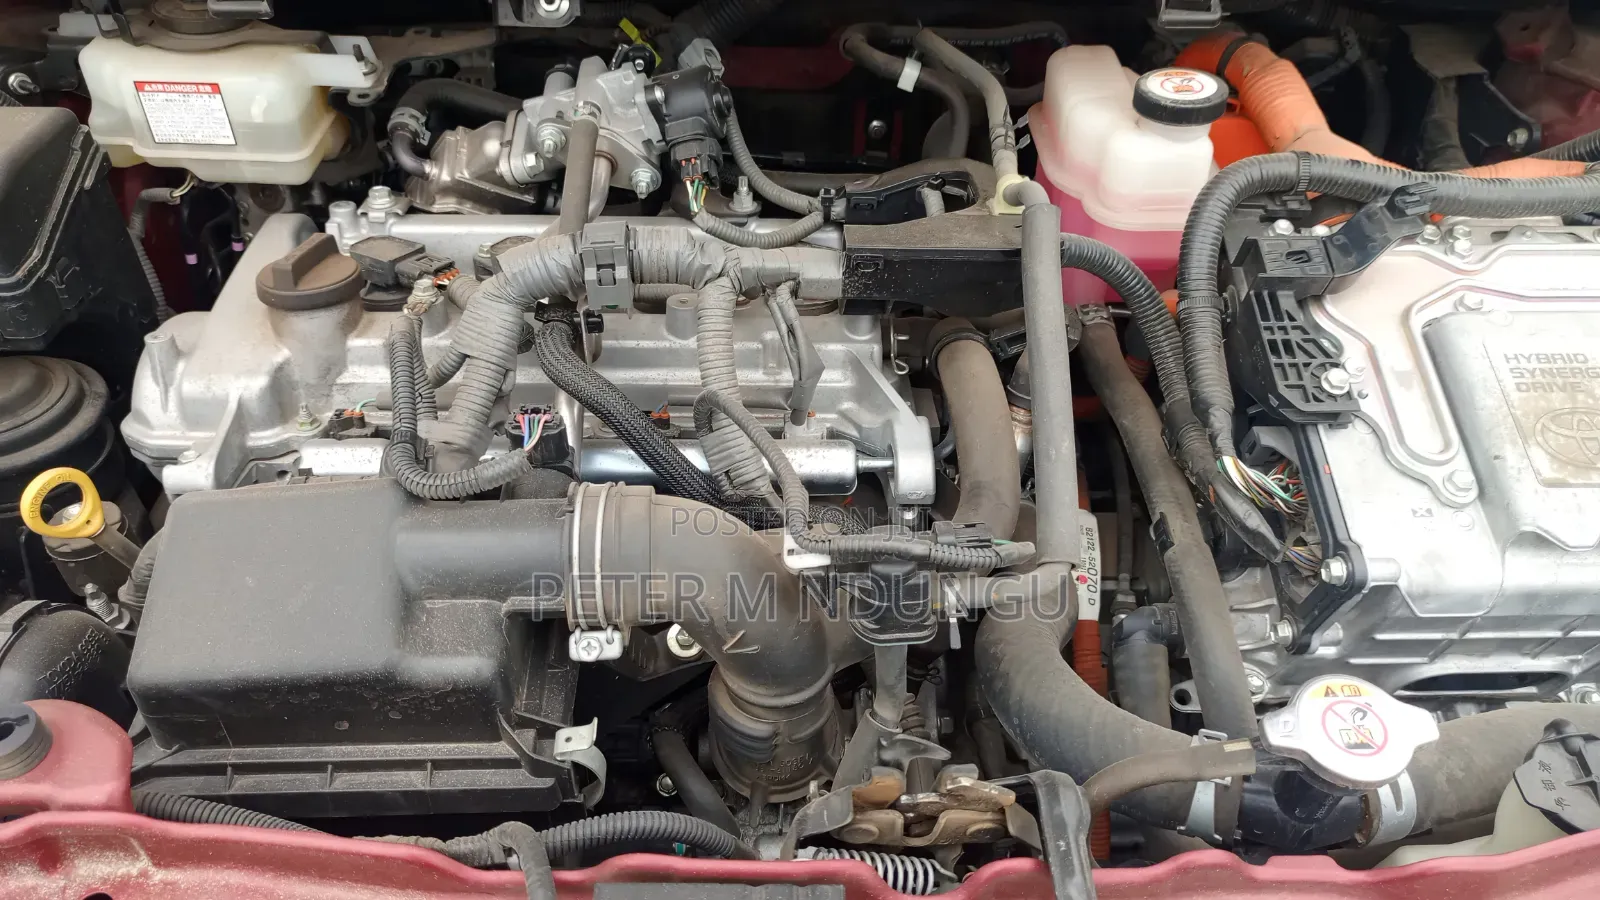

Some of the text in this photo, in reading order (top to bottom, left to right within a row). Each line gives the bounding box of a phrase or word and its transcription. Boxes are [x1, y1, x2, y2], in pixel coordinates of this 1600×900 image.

[164, 83, 199, 93] DANGER
[1503, 353, 1589, 364] HYBRID
[1514, 381, 1585, 393] DRIVE
[29, 472, 73, 519] ENGINE OIL
[1088, 597, 1096, 606] D
